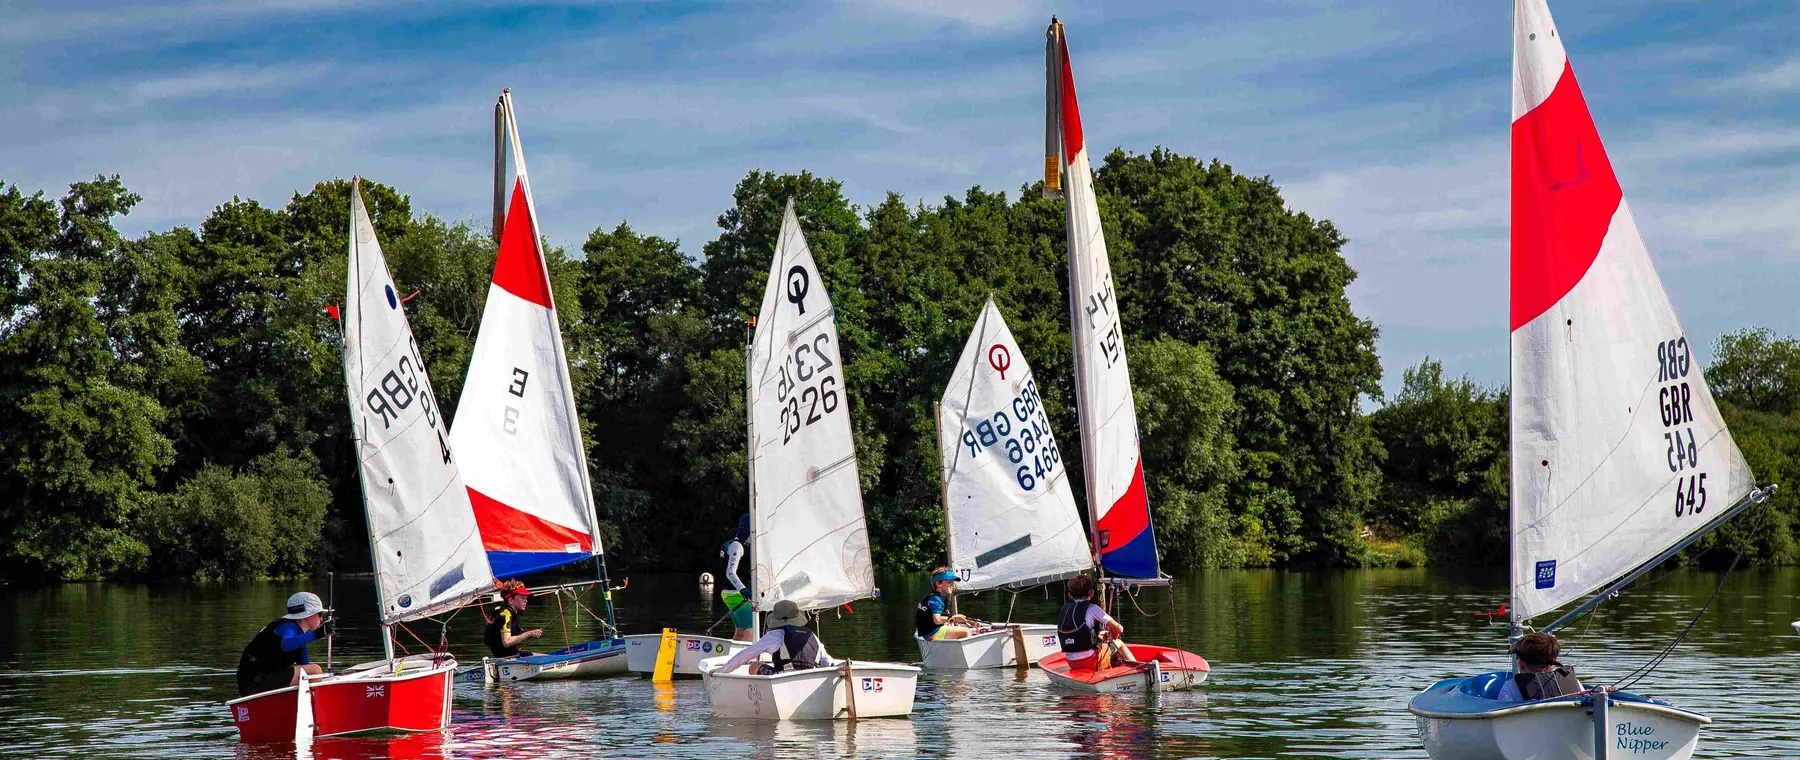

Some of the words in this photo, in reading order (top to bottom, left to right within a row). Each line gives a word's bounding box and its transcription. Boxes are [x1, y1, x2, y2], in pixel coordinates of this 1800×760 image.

[780, 375, 838, 446] 2326
[1012, 380, 1041, 423] GBR
[1658, 382, 1694, 428] GBR
[1016, 437, 1059, 492] 6466
[1675, 472, 1707, 518] 645
[1616, 722, 1656, 736] Blue
[1616, 737, 1669, 754] Nipper
